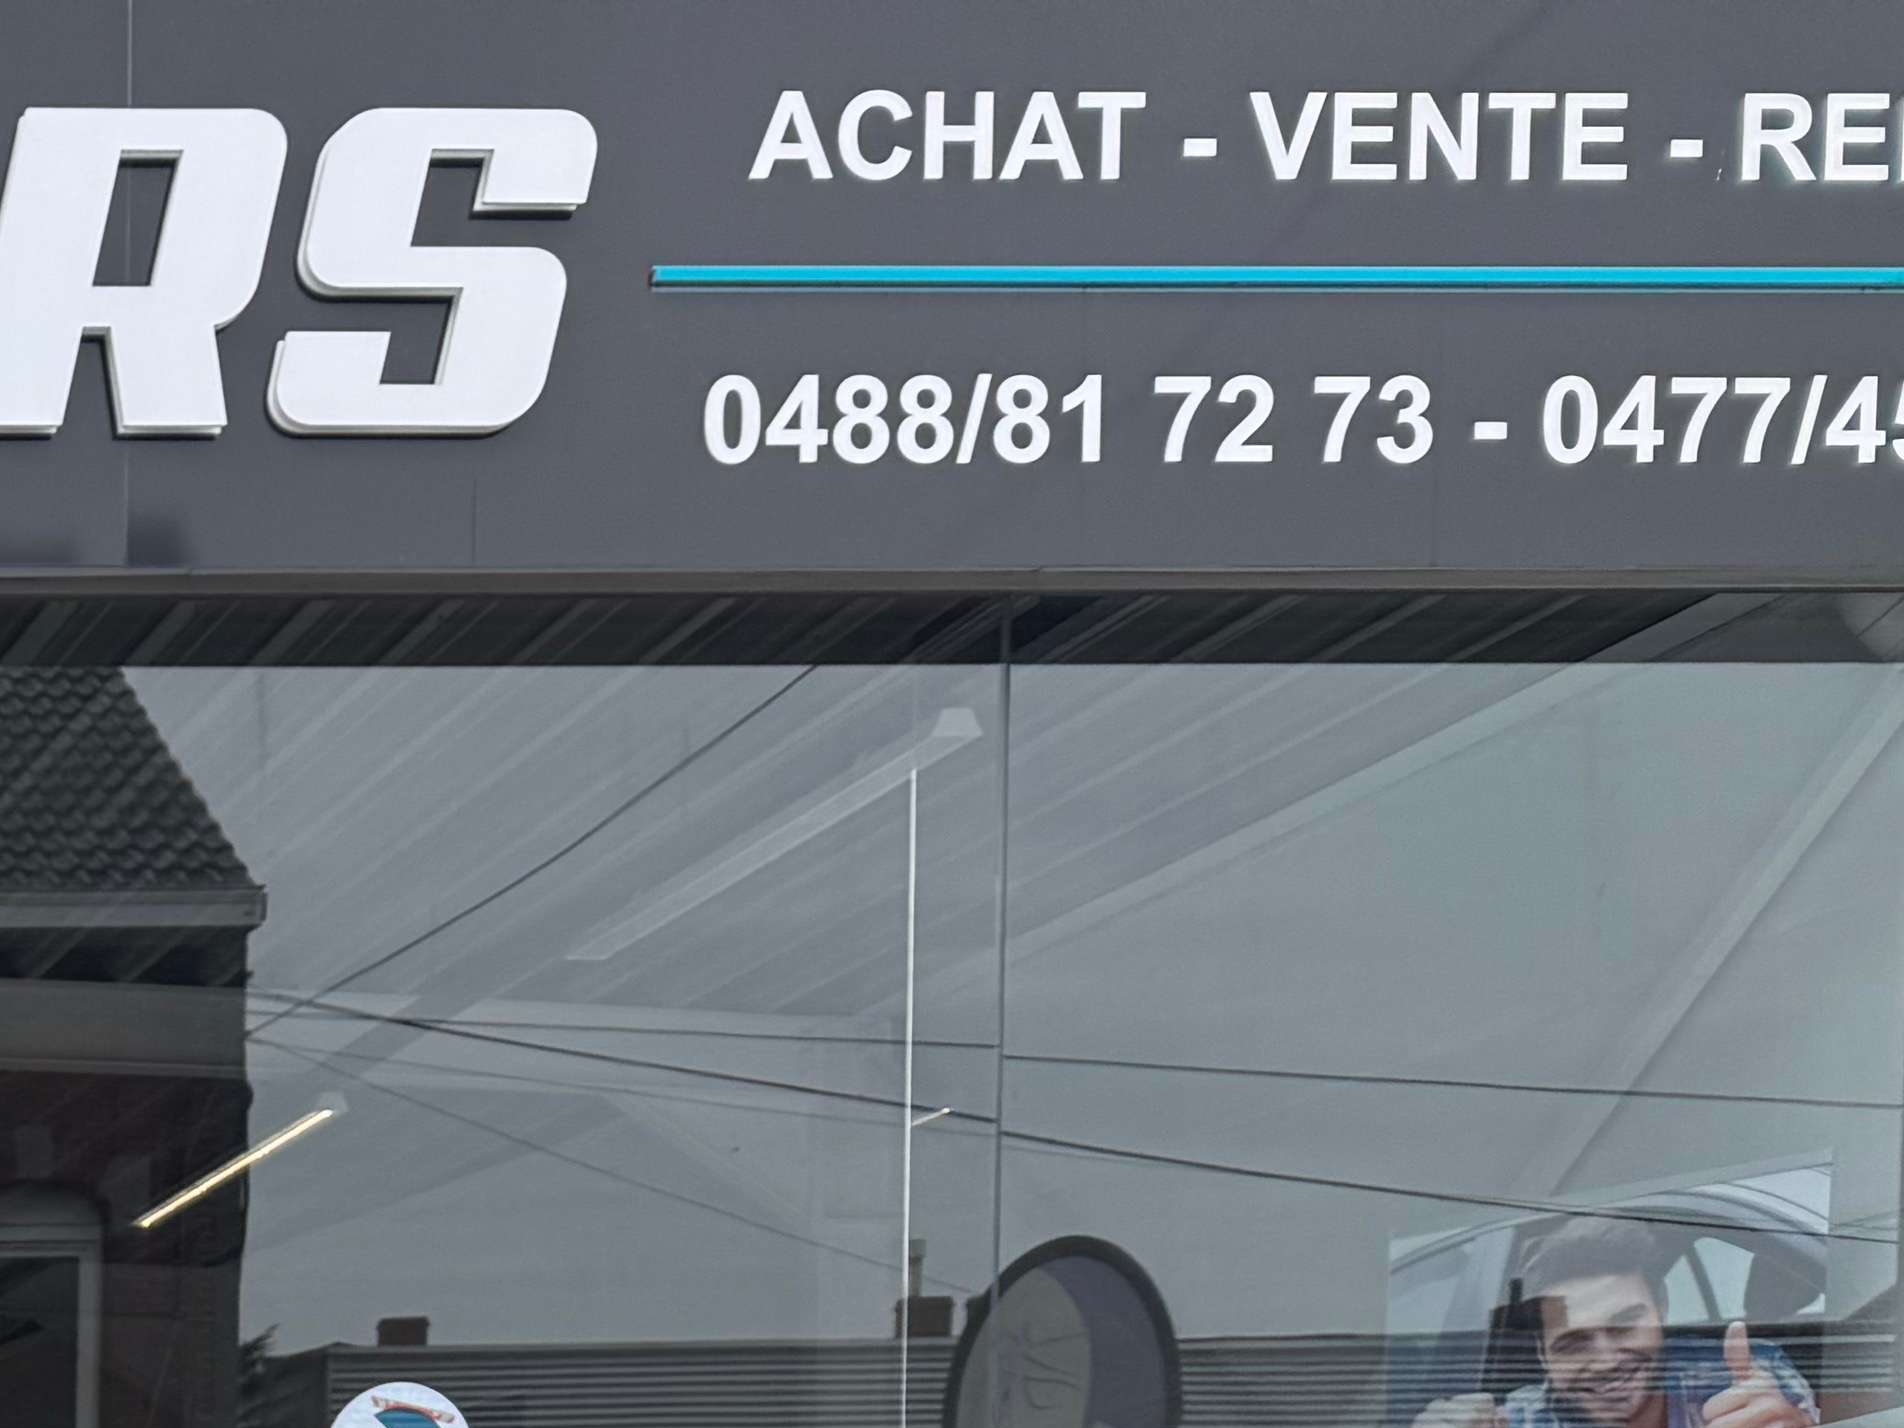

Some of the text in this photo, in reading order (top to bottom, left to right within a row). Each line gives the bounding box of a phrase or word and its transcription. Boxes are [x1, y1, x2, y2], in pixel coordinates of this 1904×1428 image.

[747, 89, 1148, 182] ACHAT
[1248, 90, 1630, 182] VENTE
[1739, 91, 1904, 182] RE
[702, 373, 1103, 465] 0488/81
[1152, 374, 1276, 464] 72
[1312, 374, 1435, 465] 73
